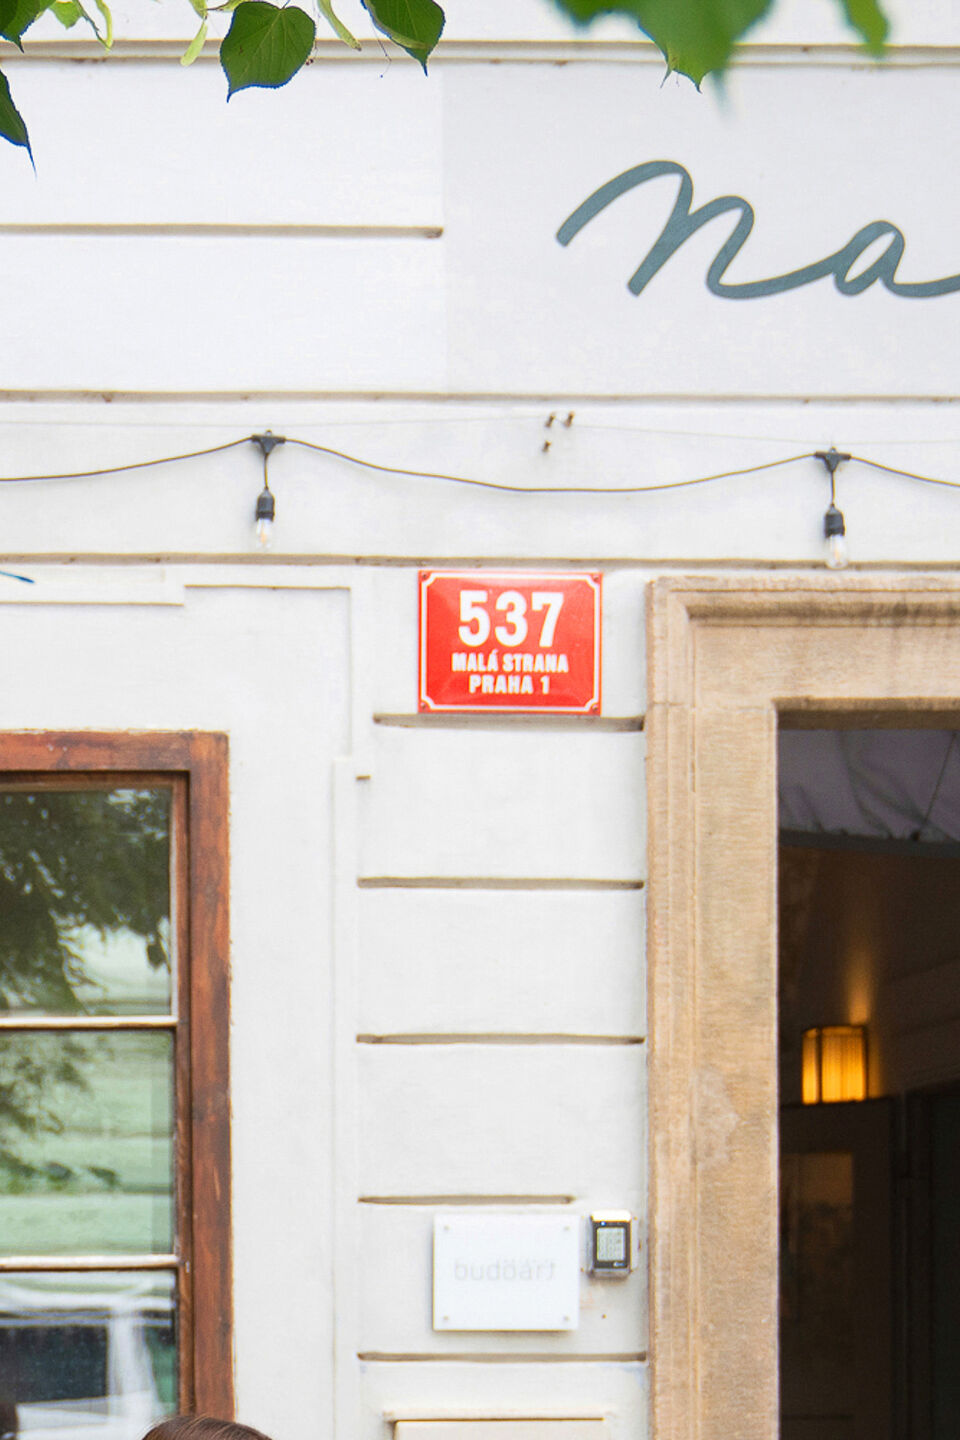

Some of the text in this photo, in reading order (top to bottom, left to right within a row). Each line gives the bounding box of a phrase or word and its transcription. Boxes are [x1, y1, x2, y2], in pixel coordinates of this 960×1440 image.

[458, 589, 564, 648] 537
[451, 649, 569, 673] MALÁ STRANA
[468, 674, 551, 695] PRAHA 1
